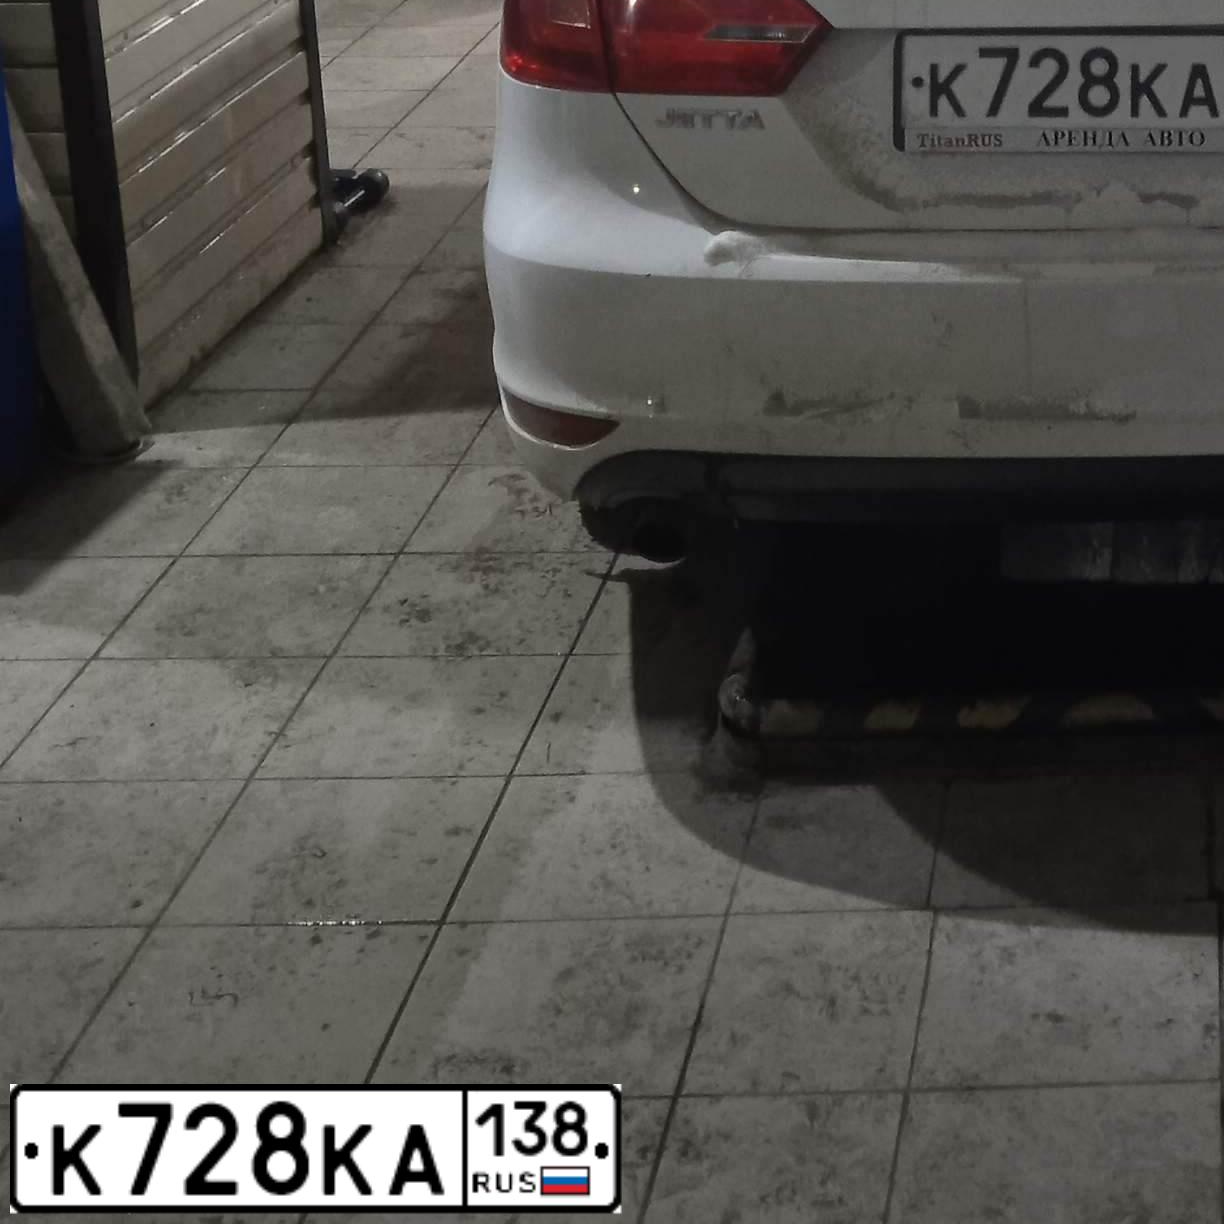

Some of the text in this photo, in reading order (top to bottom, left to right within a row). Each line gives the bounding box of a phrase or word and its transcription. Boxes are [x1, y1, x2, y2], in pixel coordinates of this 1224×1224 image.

[917, 132, 1003, 149] TitanRUS
[1036, 129, 1207, 149] АРЕНДА АВТО
